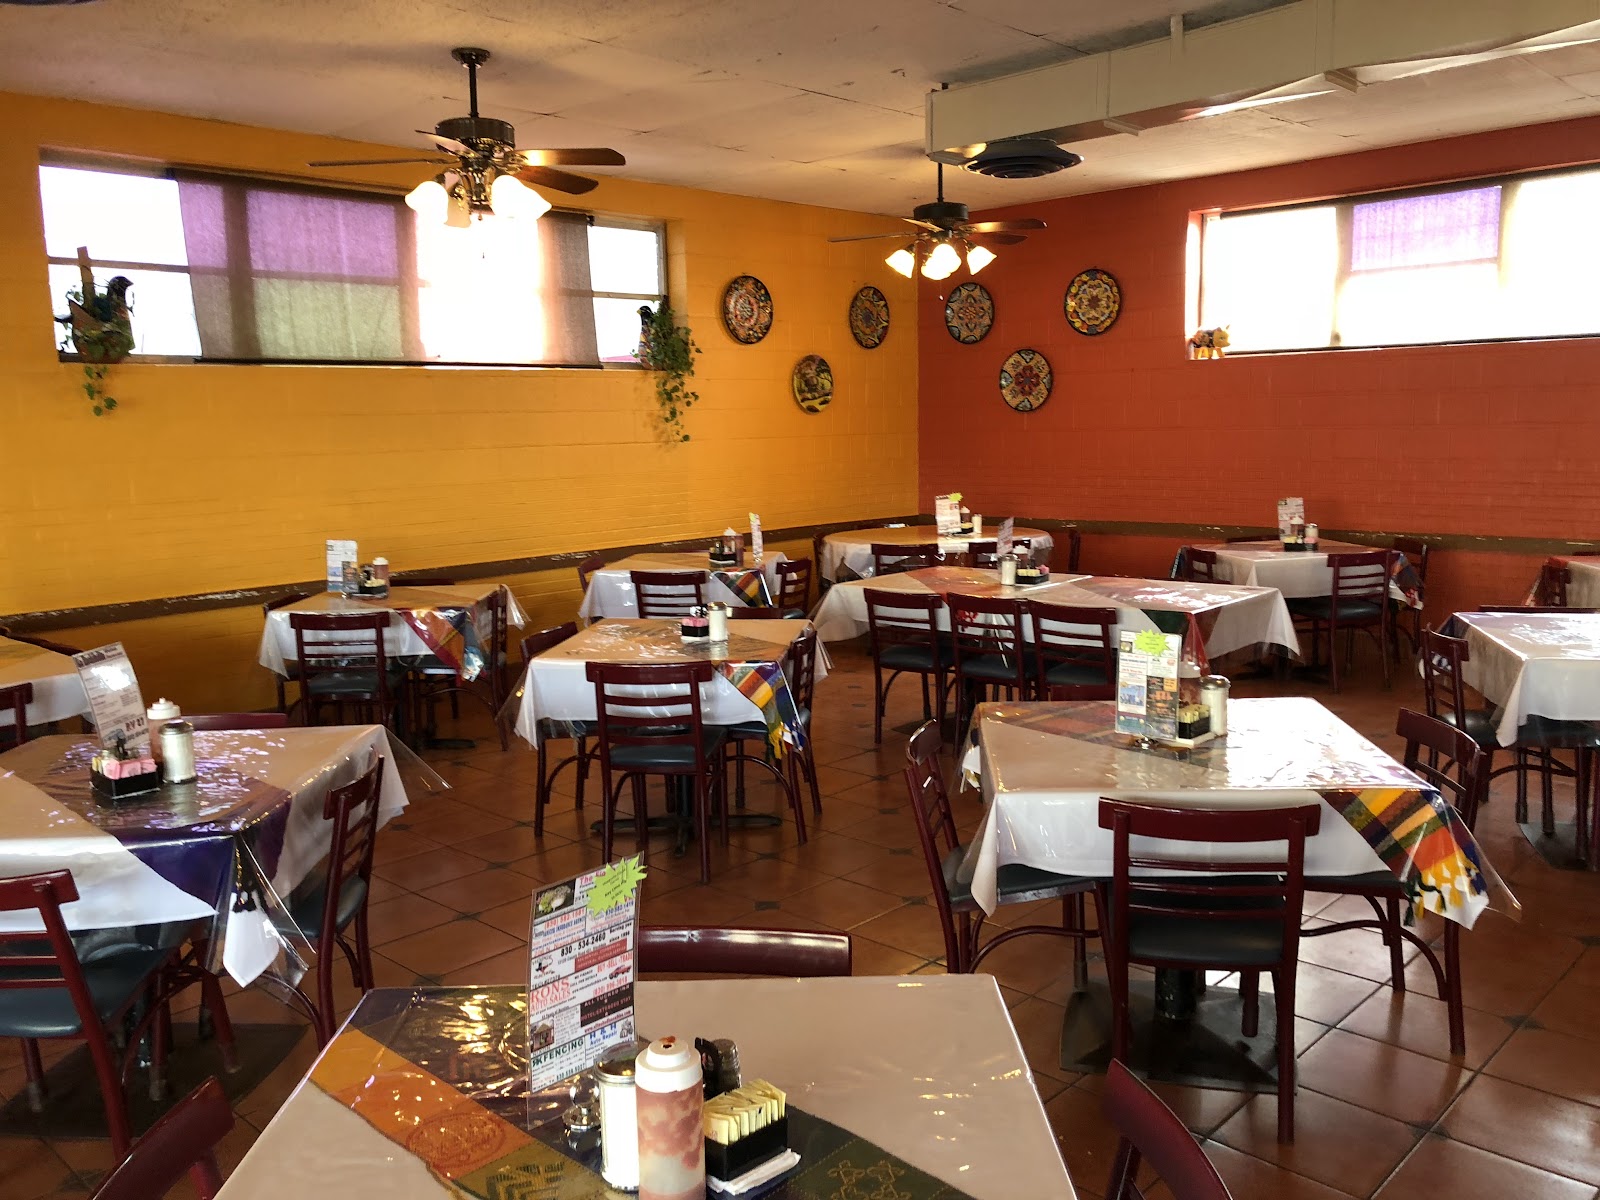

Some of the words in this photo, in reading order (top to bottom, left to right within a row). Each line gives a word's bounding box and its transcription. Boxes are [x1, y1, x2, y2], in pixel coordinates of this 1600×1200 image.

[580, 876, 592, 885] The
[610, 924, 624, 934] Serving
[560, 945, 572, 957] 830
[531, 978, 570, 1003] RONS
[594, 990, 619, 1004] TUCKED
[531, 996, 549, 1012] AUTO
[550, 990, 571, 1004] SALES
[610, 1023, 617, 1031] H
[590, 1037, 601, 1046] Auto
[602, 1031, 618, 1041] Repair
[544, 1039, 584, 1062] FENCING
